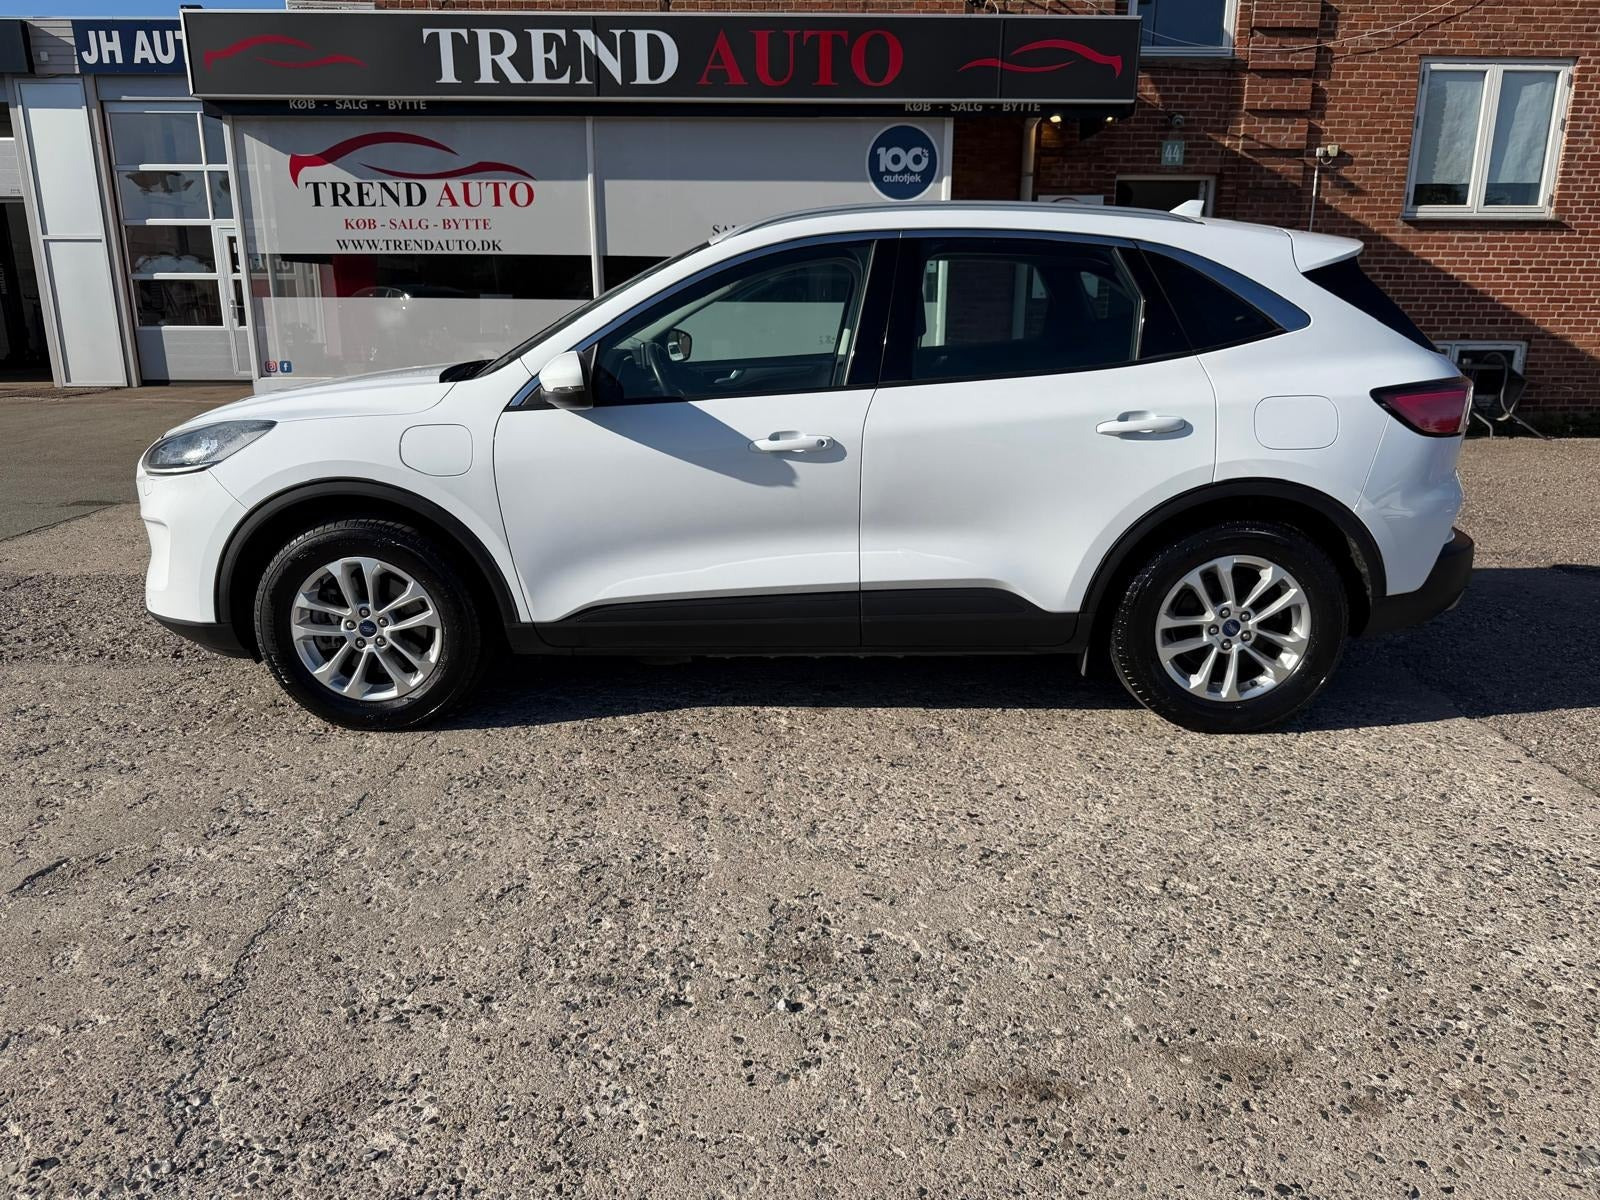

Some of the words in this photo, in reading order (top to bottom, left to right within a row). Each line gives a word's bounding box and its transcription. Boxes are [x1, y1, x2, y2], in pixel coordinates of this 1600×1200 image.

[81, 30, 123, 65] JH
[422, 28, 679, 86] TREND
[696, 28, 904, 87] AUTO
[289, 99, 316, 110] KØB
[335, 99, 368, 110] SALG
[388, 99, 427, 110] BYTTE
[904, 102, 932, 112] KØB
[950, 102, 983, 112] SALG
[1002, 102, 1041, 112] BYTTE
[1164, 144, 1180, 162] 44
[882, 172, 921, 185] autotjek
[305, 181, 427, 208] TREND
[436, 181, 535, 208] AUTO
[344, 218, 377, 230] KØB
[389, 218, 429, 230] SALG
[442, 218, 492, 230] BYTTE
[336, 239, 503, 252] WWW.TRENDAUTO.DK
